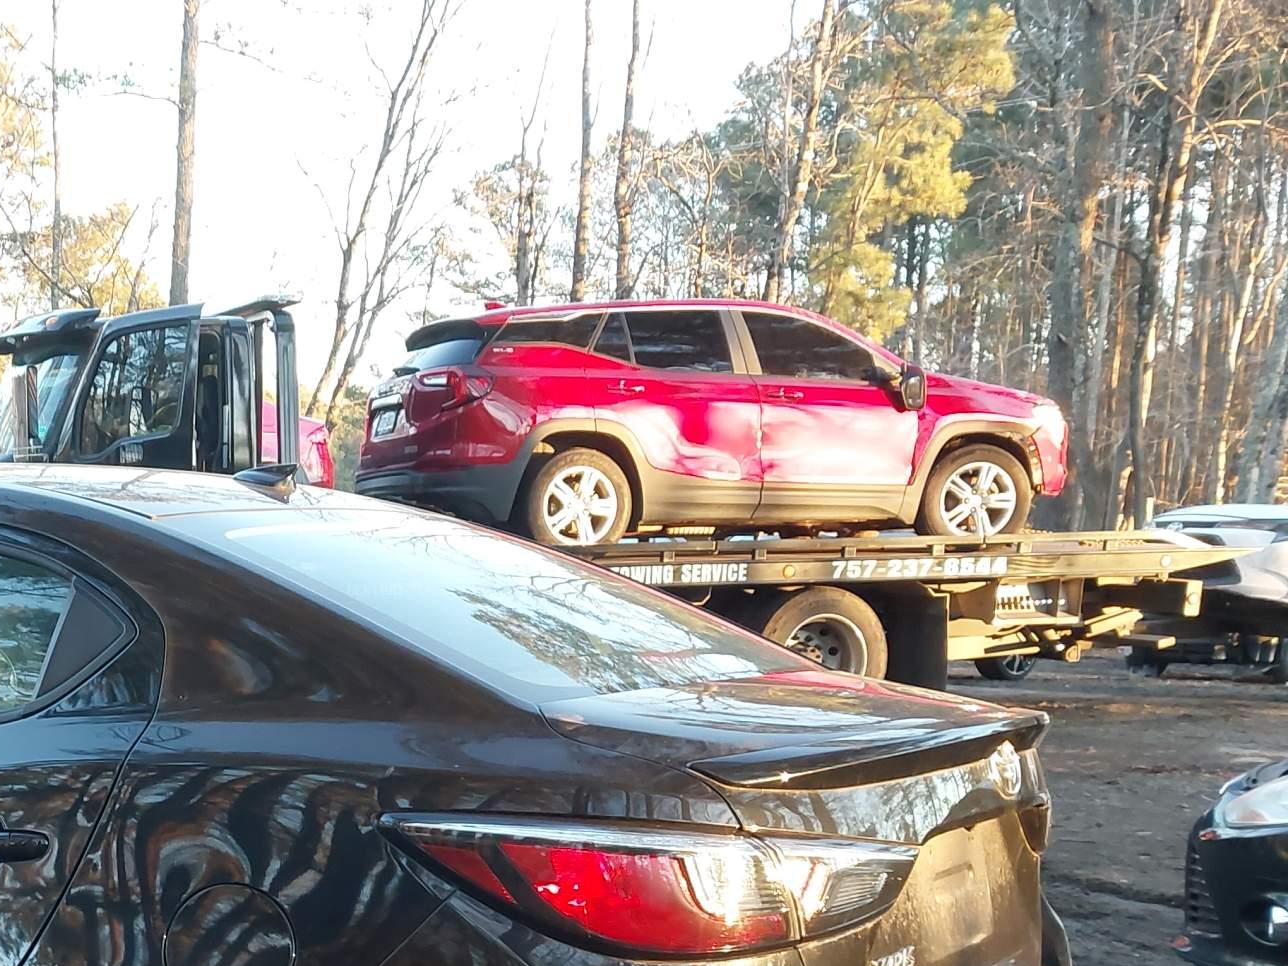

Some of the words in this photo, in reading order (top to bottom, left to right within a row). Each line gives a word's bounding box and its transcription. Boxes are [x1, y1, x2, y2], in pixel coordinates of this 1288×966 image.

[609, 564, 675, 585] OWING
[681, 562, 748, 584] SERVICE
[831, 556, 1009, 579] 757-237-6544
